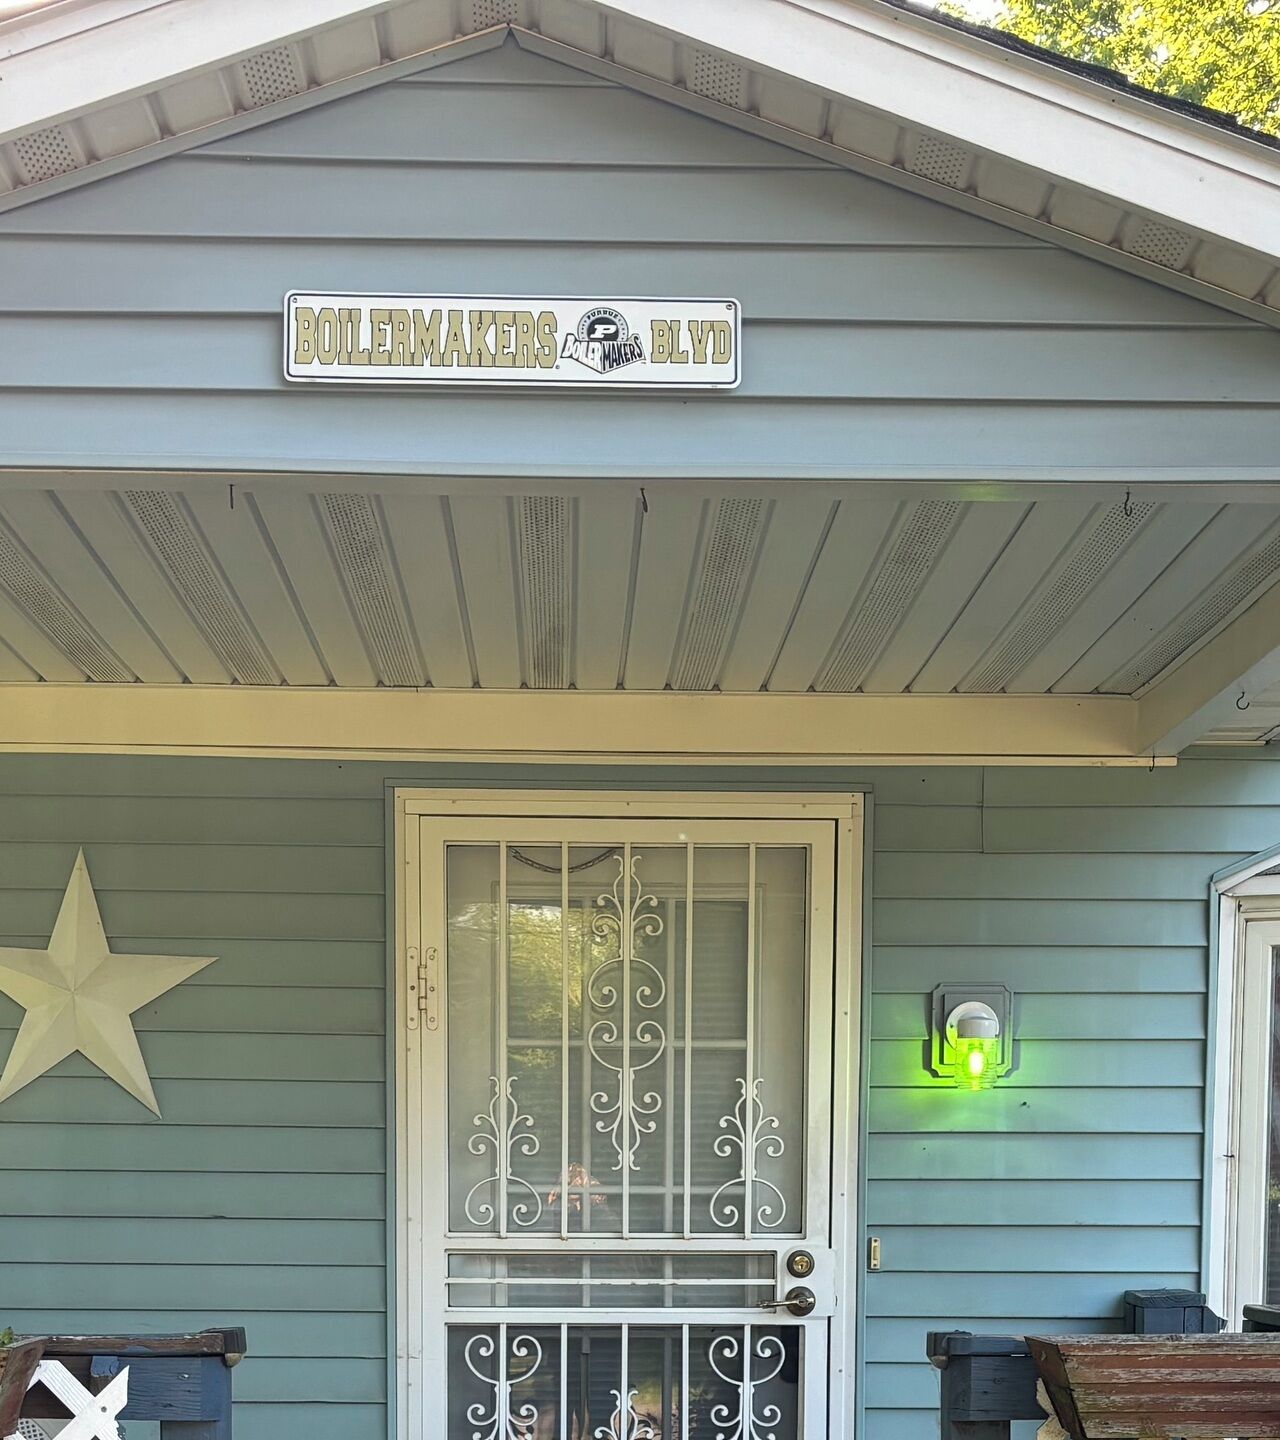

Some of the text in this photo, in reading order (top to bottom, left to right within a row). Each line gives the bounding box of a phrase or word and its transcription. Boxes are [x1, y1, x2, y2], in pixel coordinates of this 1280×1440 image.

[294, 306, 732, 369] BOILERMAKERS BLVD
[589, 323, 618, 339] P
